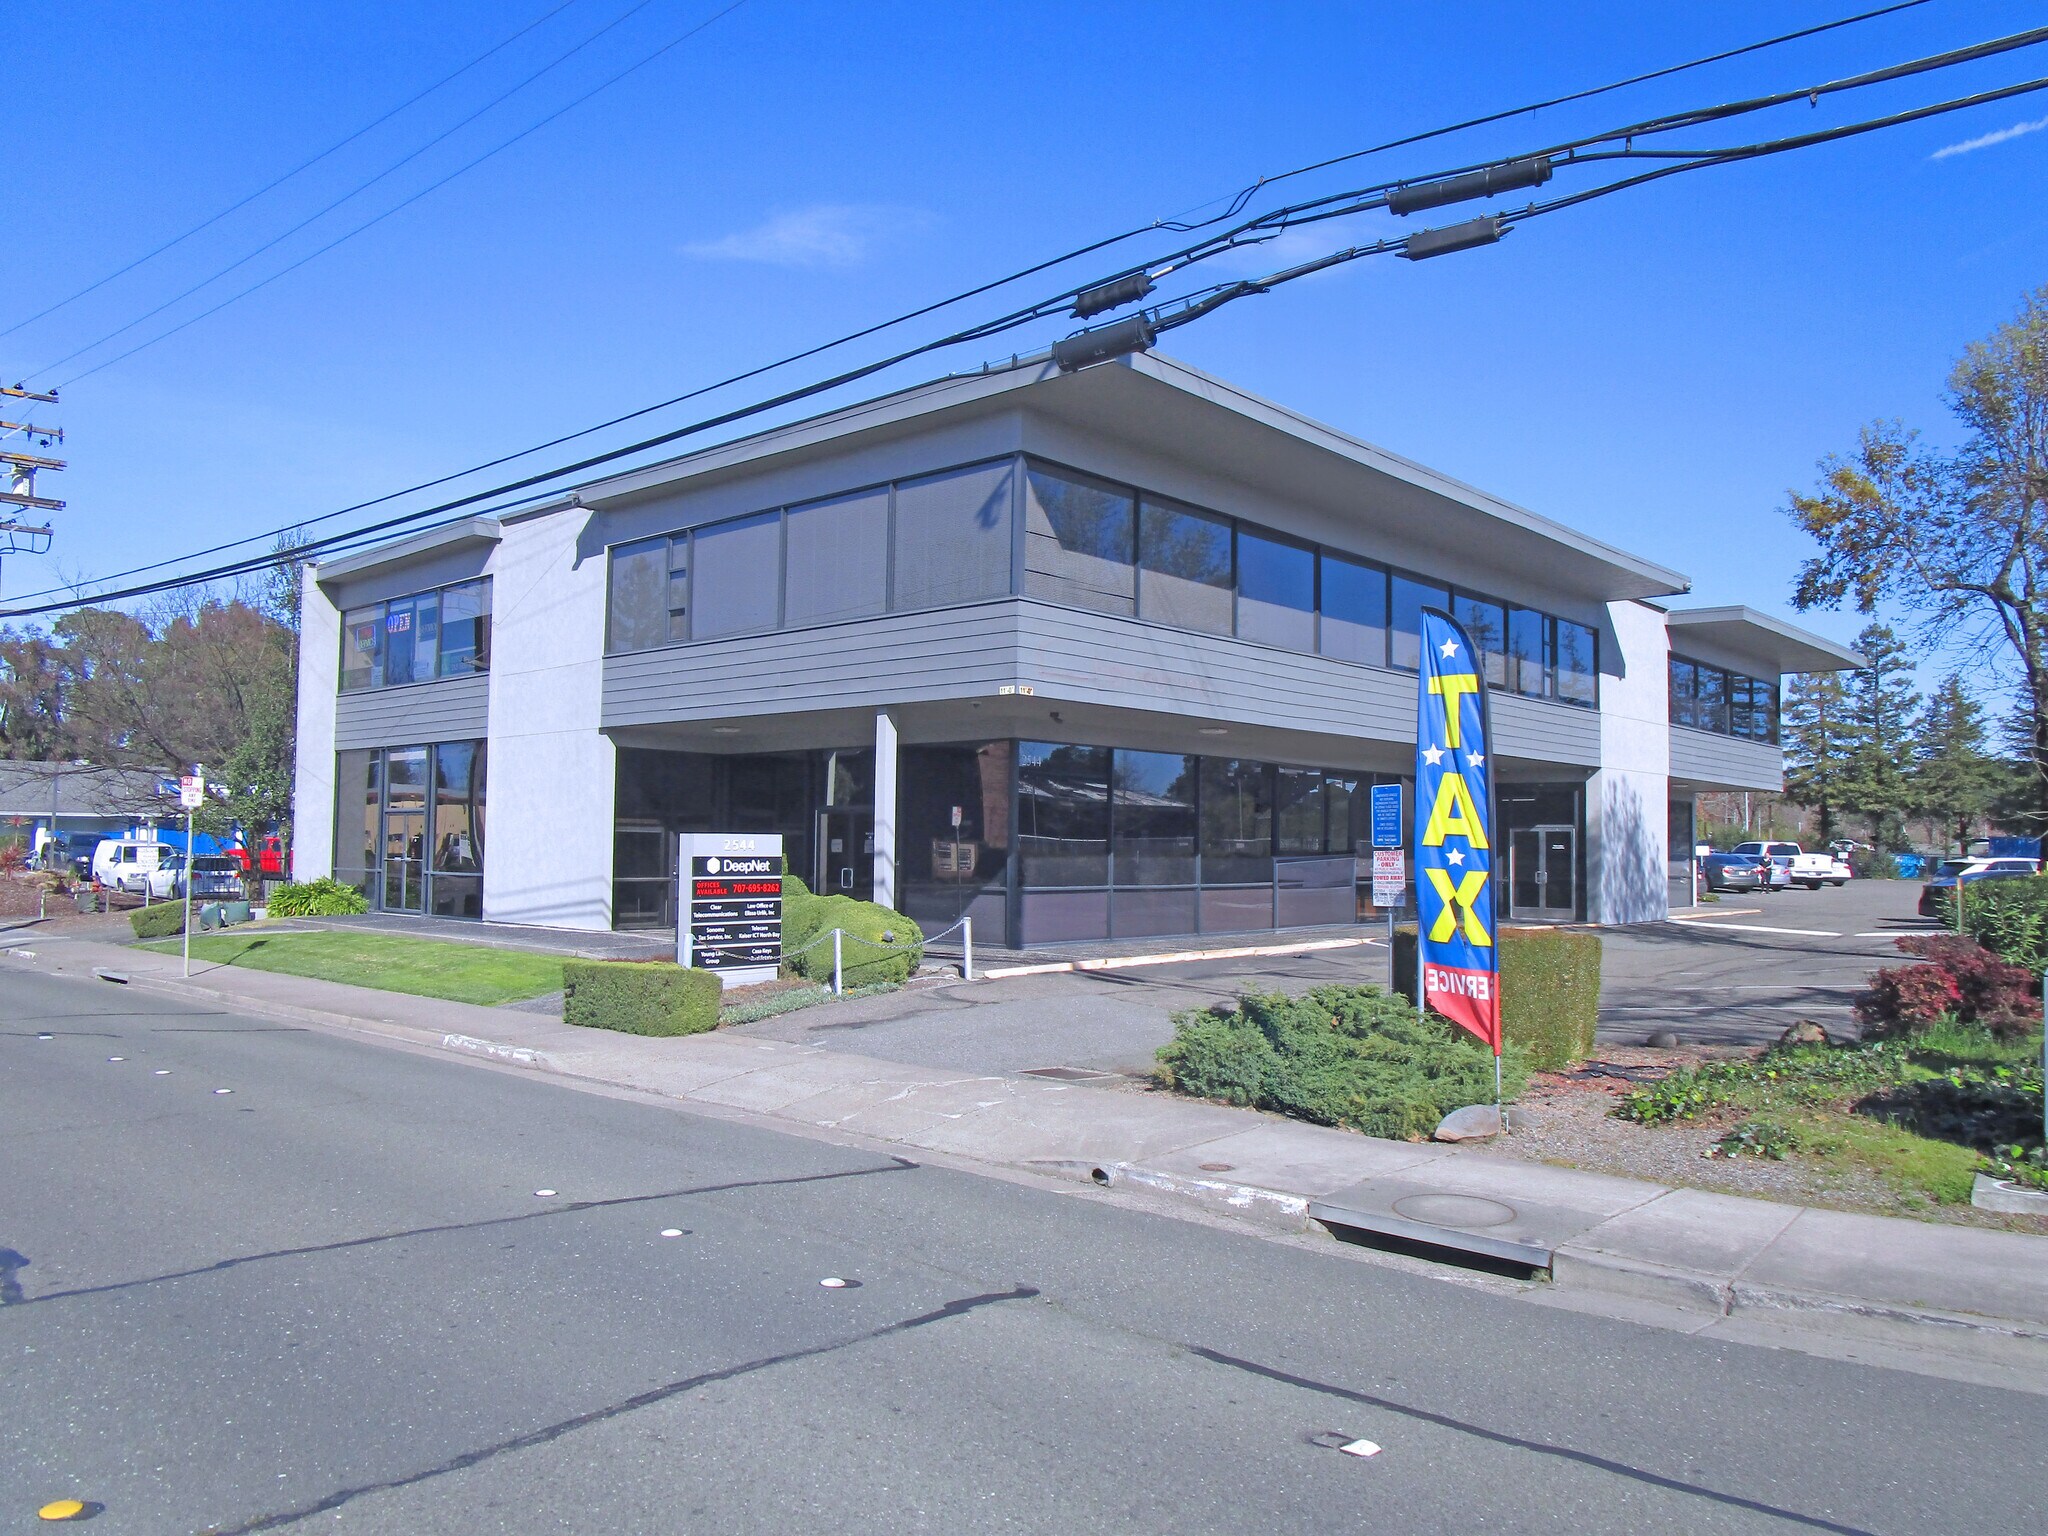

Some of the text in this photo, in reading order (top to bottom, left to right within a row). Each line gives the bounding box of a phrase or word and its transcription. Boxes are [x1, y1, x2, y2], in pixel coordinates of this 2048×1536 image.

[387, 612, 411, 634] OPEN
[1421, 673, 1492, 947] TAX
[724, 839, 755, 851] 2544
[724, 859, 770, 874] DeepNet
[733, 884, 780, 893] 707-695-8262
